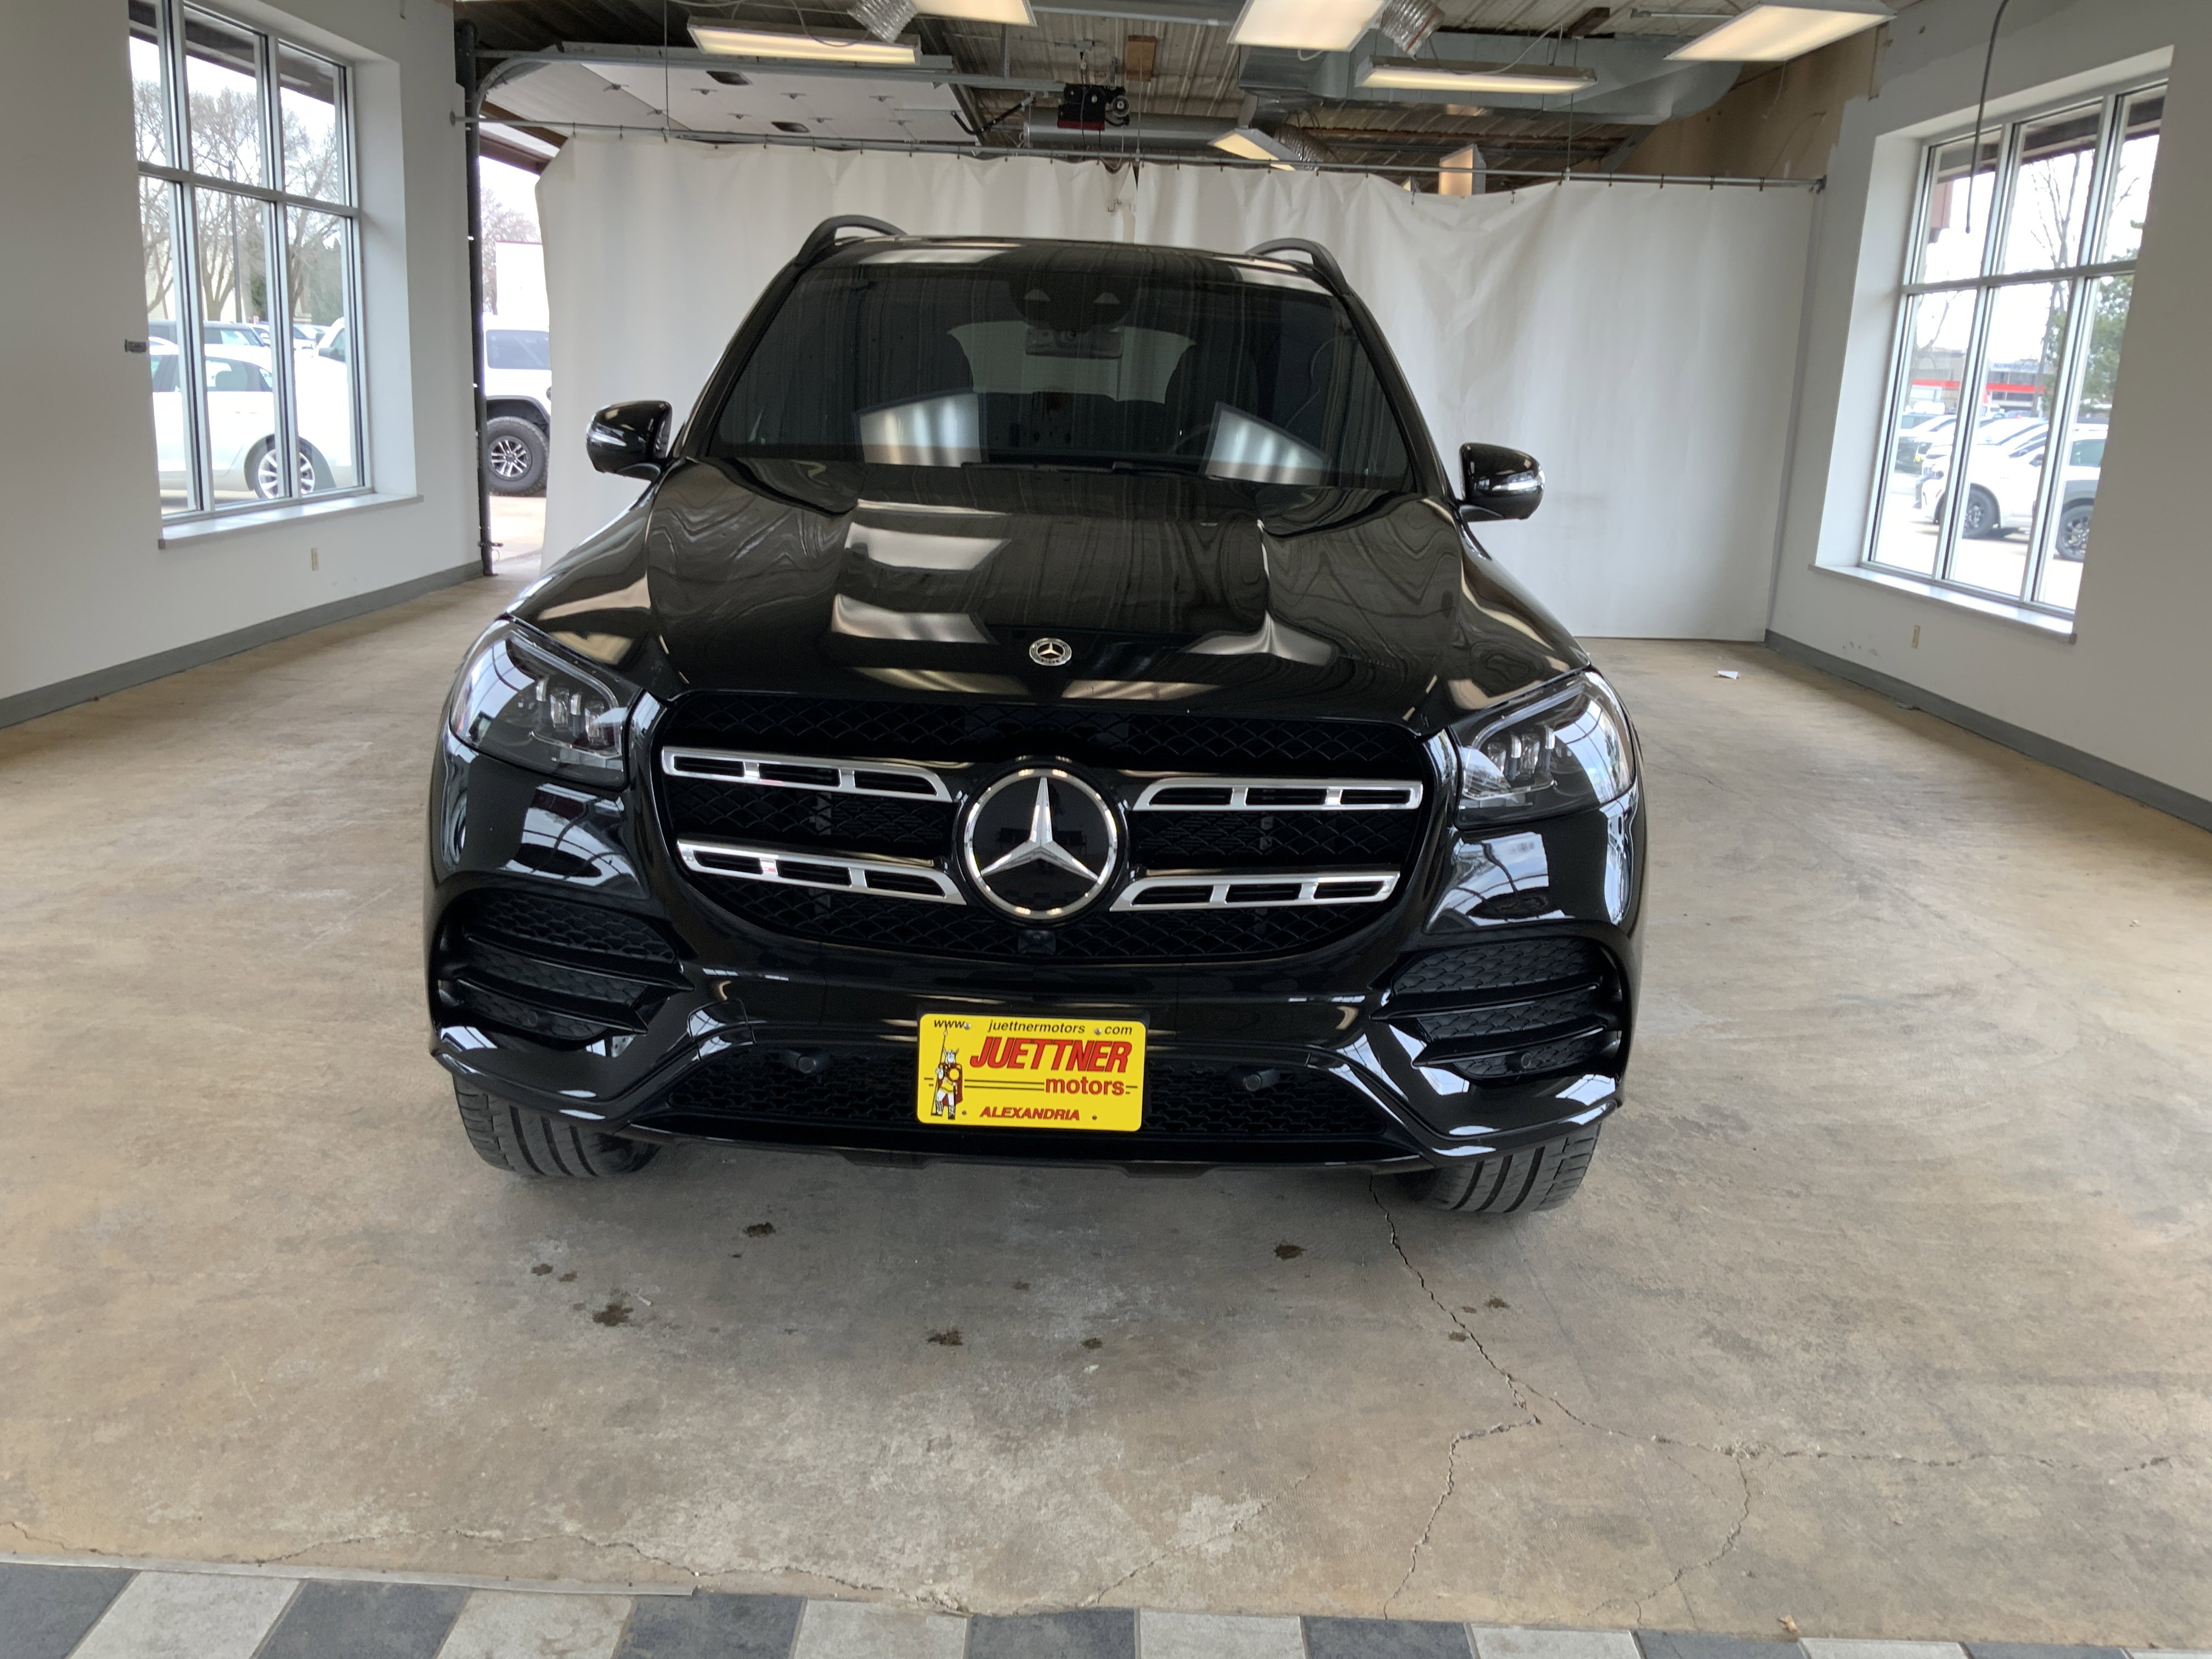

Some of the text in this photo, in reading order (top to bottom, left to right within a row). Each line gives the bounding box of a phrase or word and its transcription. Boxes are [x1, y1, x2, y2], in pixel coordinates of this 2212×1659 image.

[988, 1019, 1086, 1034] juettnermotors
[969, 1036, 1132, 1073] JUETTNER
[1045, 1076, 1125, 1095] motors
[979, 1106, 1080, 1120] ALEXANDRIA
